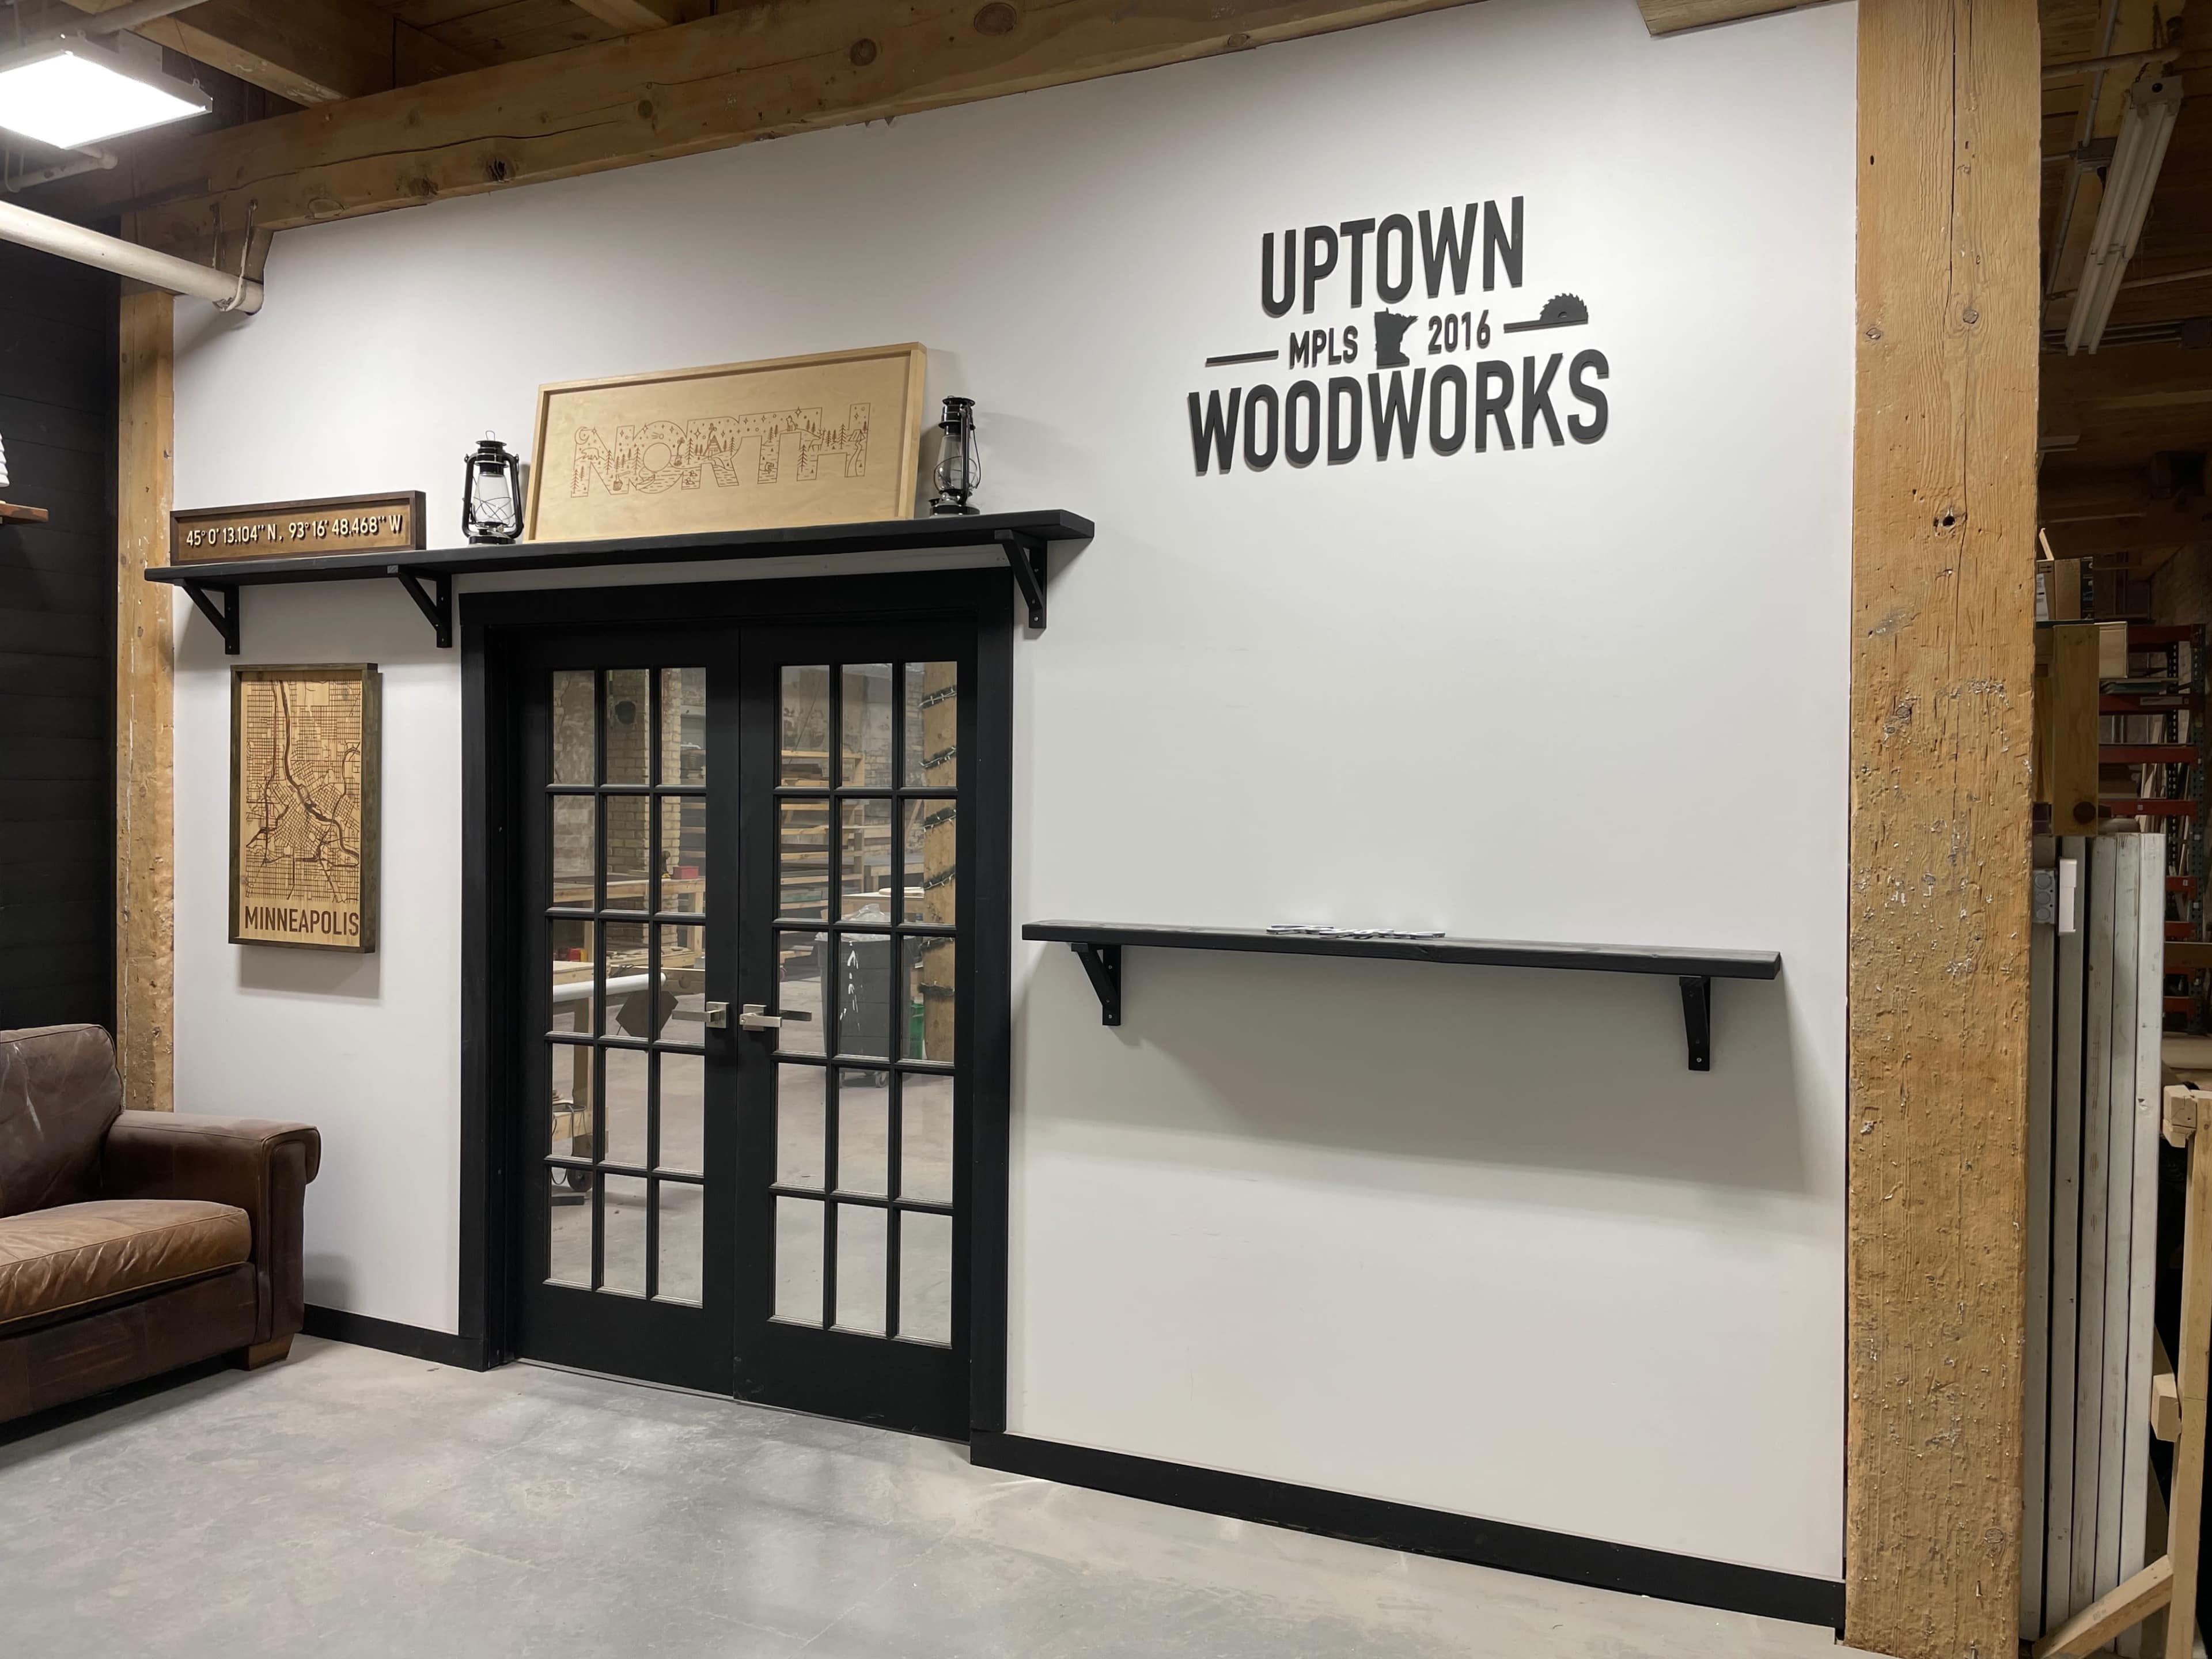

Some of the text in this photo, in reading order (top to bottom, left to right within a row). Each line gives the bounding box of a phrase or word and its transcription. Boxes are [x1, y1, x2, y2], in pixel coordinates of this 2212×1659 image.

[1262, 196, 1524, 317] UPTOWN
[1289, 309, 1491, 369] MPLS 2016
[570, 403, 871, 498] NORTH
[1188, 349, 1610, 476] WOODWORKS
[388, 514, 402, 532] W
[244, 906, 359, 937] MINNEAPOLIS
